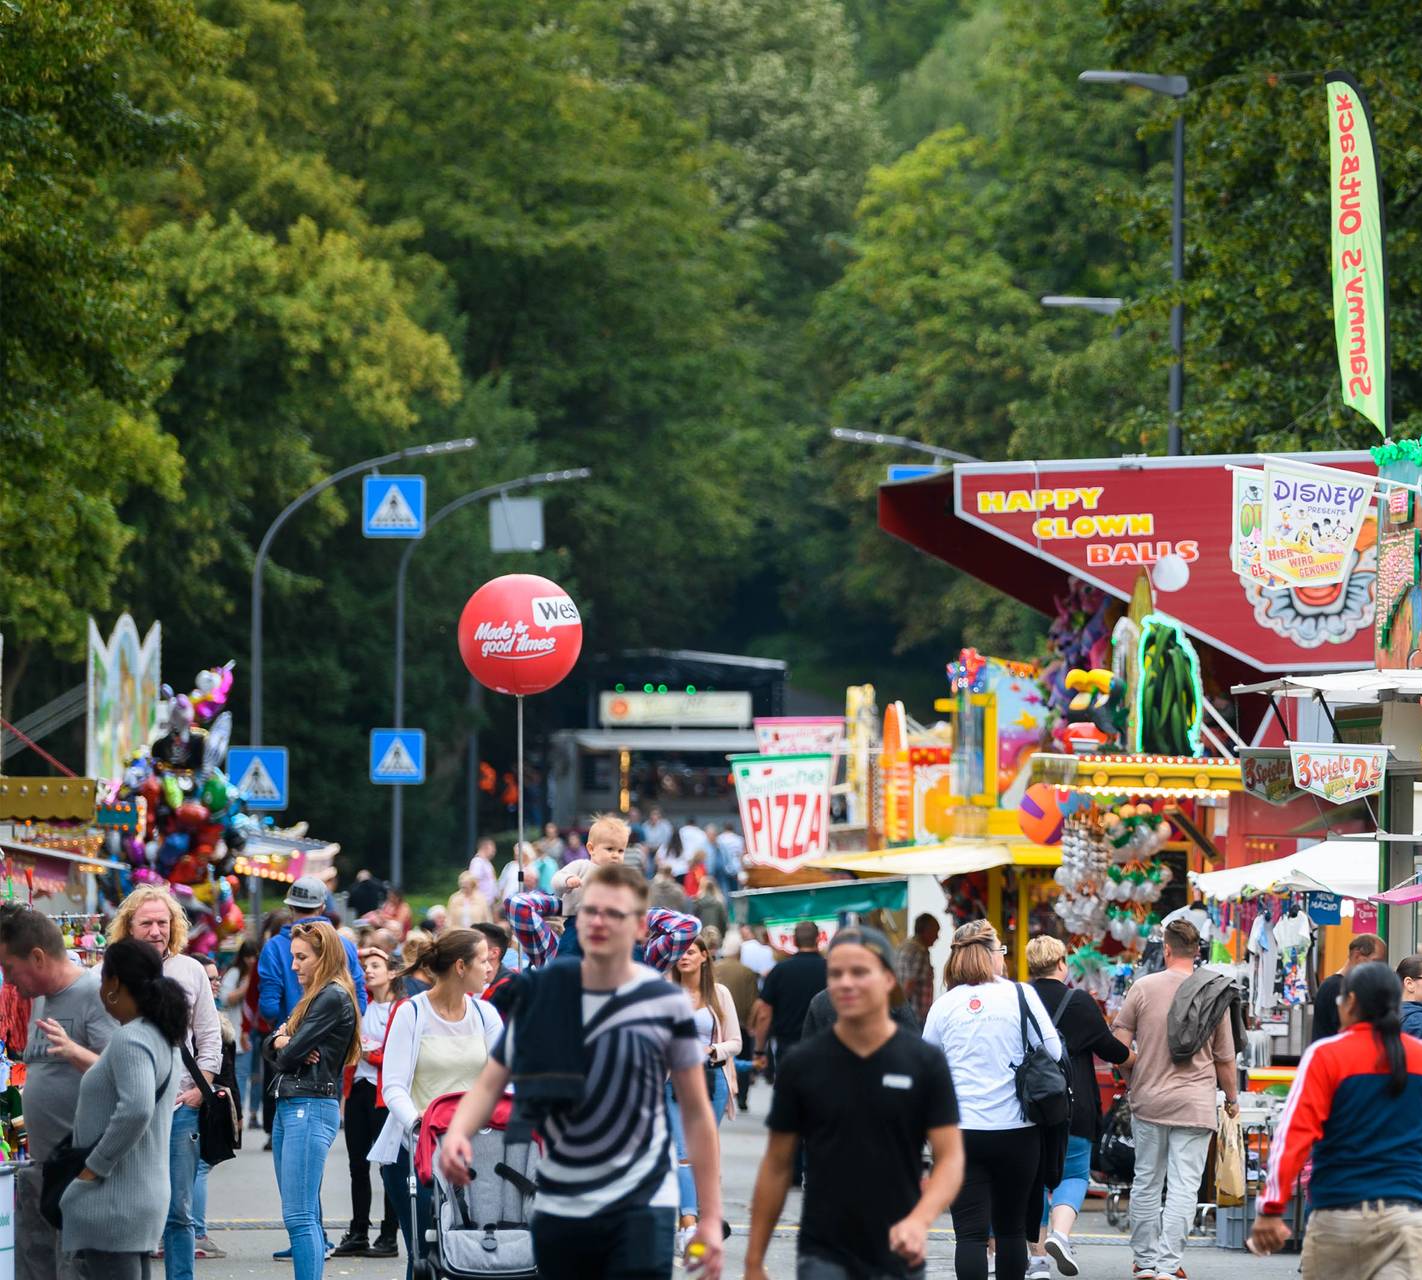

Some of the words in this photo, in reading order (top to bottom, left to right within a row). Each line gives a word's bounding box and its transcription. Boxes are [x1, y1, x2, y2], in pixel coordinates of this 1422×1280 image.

[977, 487, 1104, 513] HAPPY
[1274, 480, 1364, 513] DISNEY
[1307, 505, 1346, 516] PRESENTS
[1033, 513, 1154, 539] CLOWN
[1087, 540, 1199, 567] BALLS
[1268, 549, 1293, 561] HIER
[1289, 555, 1313, 568] WIRD
[474, 620, 512, 641] Made
[514, 619, 530, 634] for
[481, 635, 516, 657] good
[515, 634, 556, 653] times
[1297, 753, 1311, 787] 3
[746, 793, 822, 859] PIZZA
